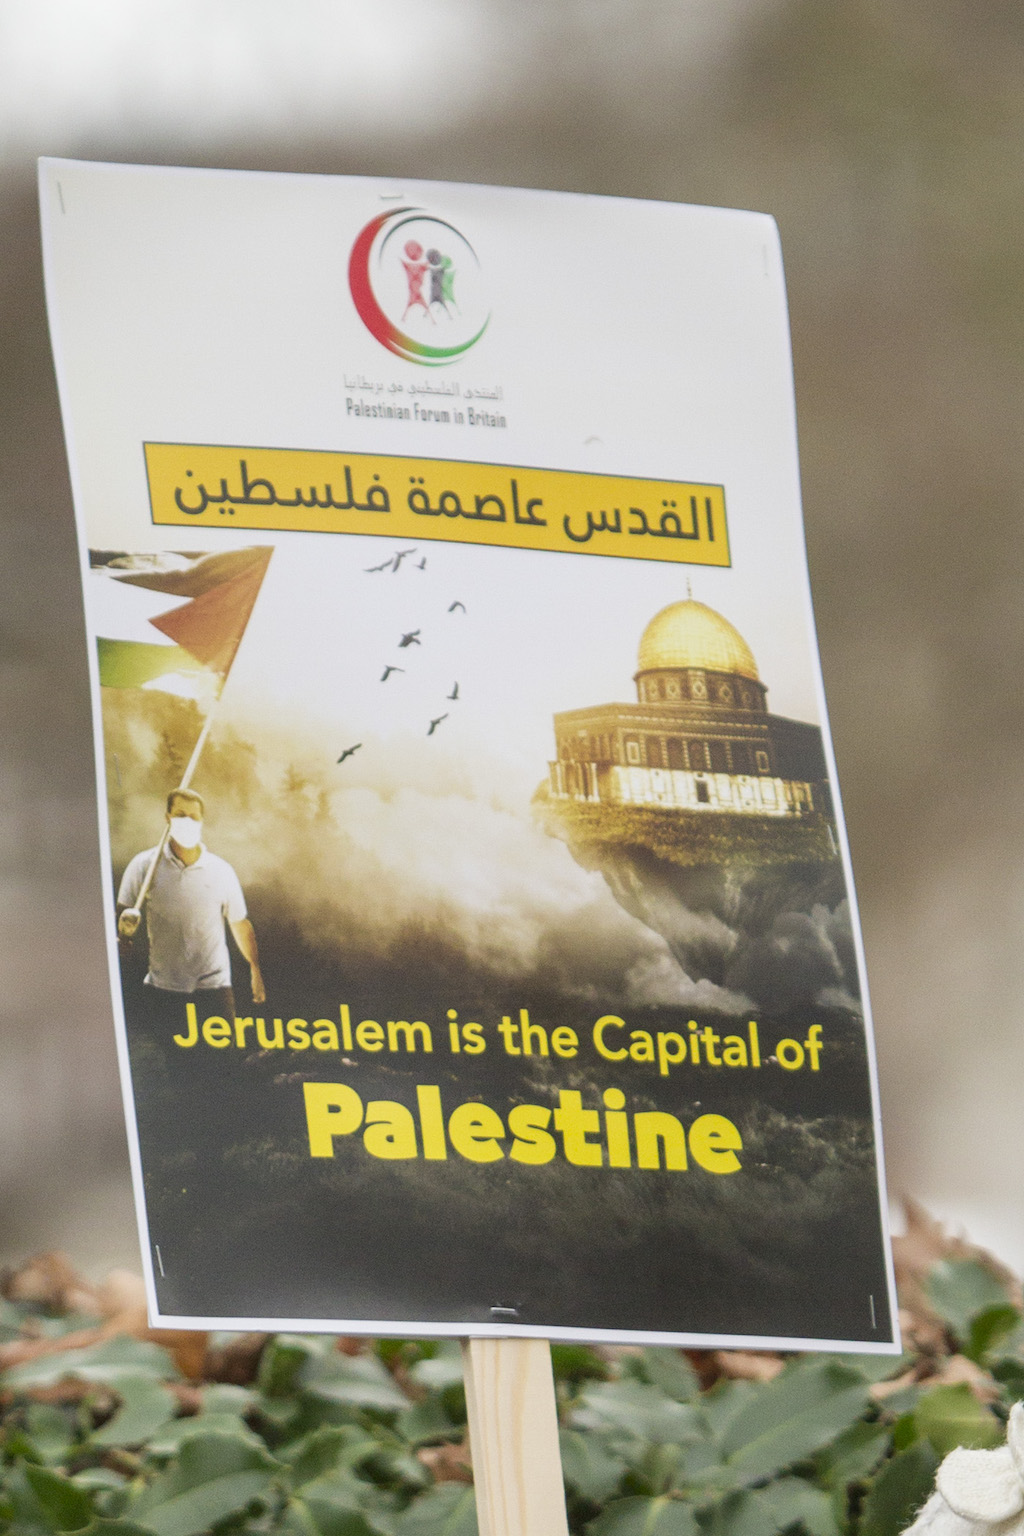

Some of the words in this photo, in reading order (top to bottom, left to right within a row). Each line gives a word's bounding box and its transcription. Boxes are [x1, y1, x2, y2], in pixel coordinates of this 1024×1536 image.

[346, 397, 411, 420] Palestinian
[414, 402, 451, 424] Forum
[454, 408, 465, 425] in
[467, 407, 508, 429] Britain
[174, 460, 391, 515] فلسطين
[407, 475, 548, 527] عاصمة
[562, 496, 715, 543] القدس
[173, 1003, 433, 1053] Jerusalem
[448, 1009, 487, 1055] is
[497, 1008, 579, 1058] the
[592, 1015, 761, 1076] Capital
[775, 1024, 824, 1071] of
[302, 1081, 743, 1175] Palestine
